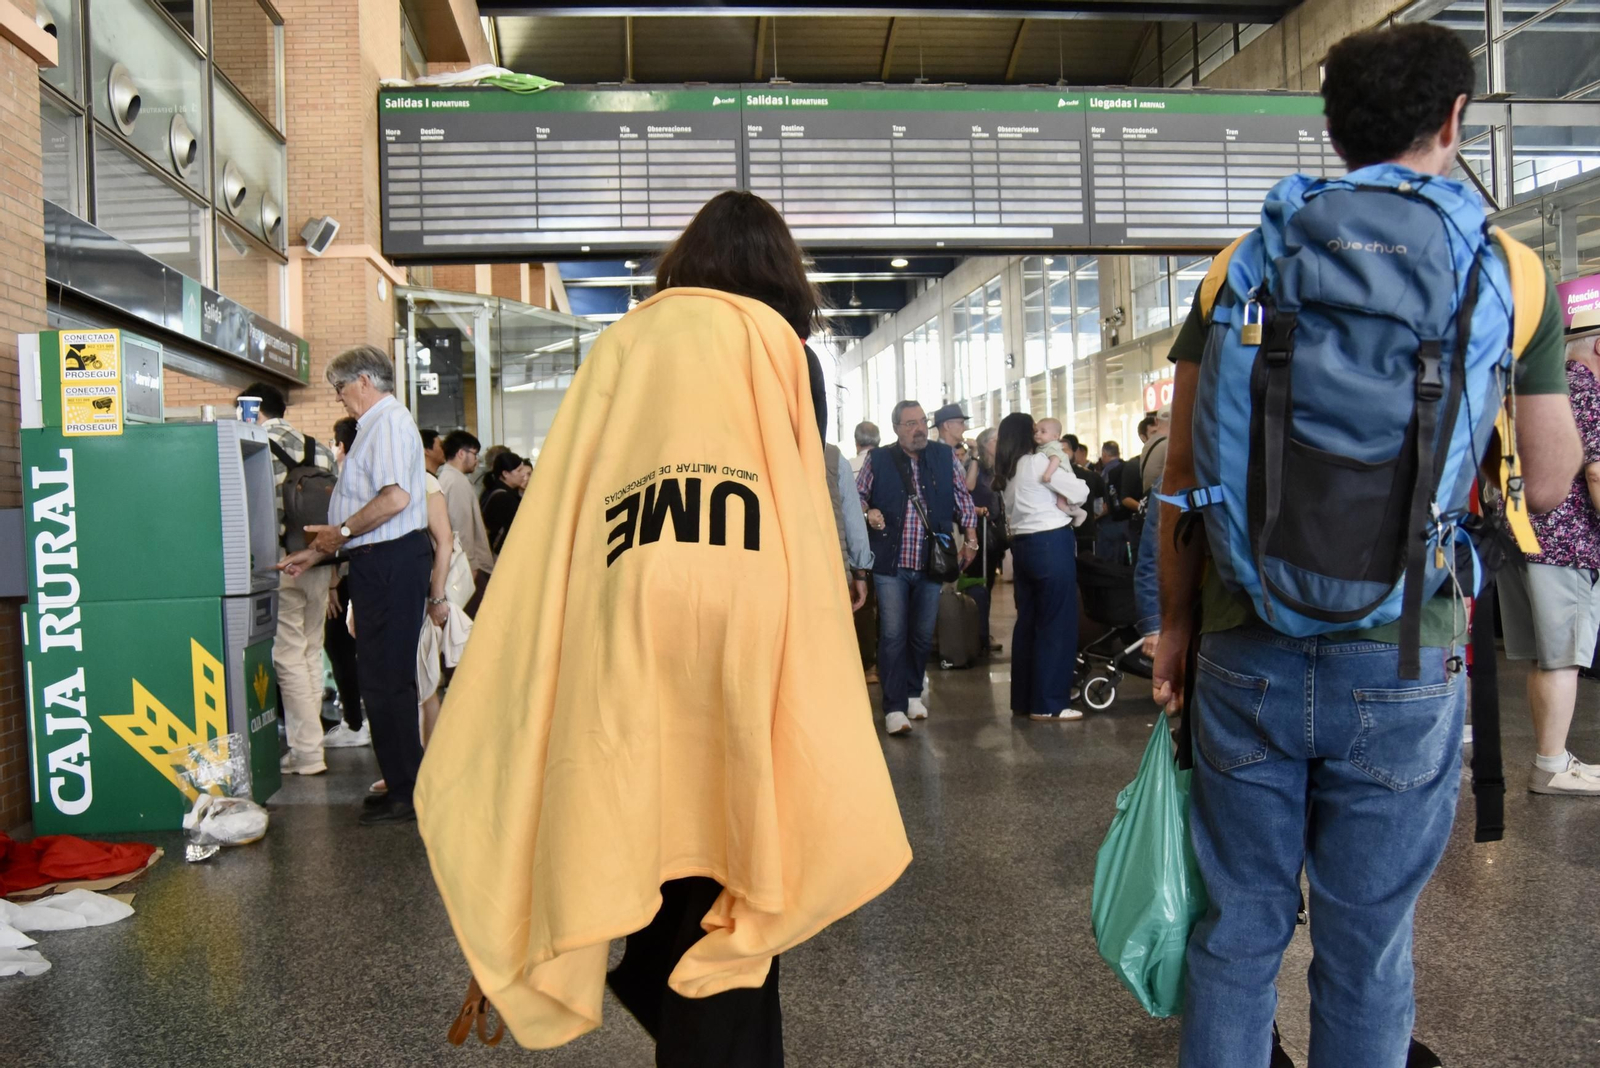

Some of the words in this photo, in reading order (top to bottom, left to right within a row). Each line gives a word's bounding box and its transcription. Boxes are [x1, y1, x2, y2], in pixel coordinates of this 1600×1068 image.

[385, 98, 423, 109] Salidas
[431, 100, 470, 108] DEPARTURES
[747, 95, 783, 106] Salidas
[791, 98, 829, 106] DEPARTURES
[1089, 97, 1132, 110] Llegadas
[1139, 101, 1166, 109] ARRIVALS
[420, 127, 445, 135] Destino
[647, 125, 692, 133] Observaciones
[781, 124, 805, 132] Destino
[997, 125, 1040, 133] Observaciones
[1122, 126, 1158, 134] Procedencia
[1327, 236, 1408, 255] Quechua
[1567, 288, 1600, 305] Atención
[64, 333, 115, 341] CONECTADA
[65, 370, 116, 379] PROSEGUR
[66, 386, 116, 394] CONECTADA
[67, 423, 118, 431] PROSEGUR
[658, 465, 671, 476] DE
[676, 463, 717, 474] MILITAR
[722, 466, 759, 482] UNIDAD
[604, 470, 656, 505] EMERGENCIAS
[605, 477, 761, 569] UME
[32, 448, 83, 654] RURAL
[44, 666, 93, 816] CAJA
